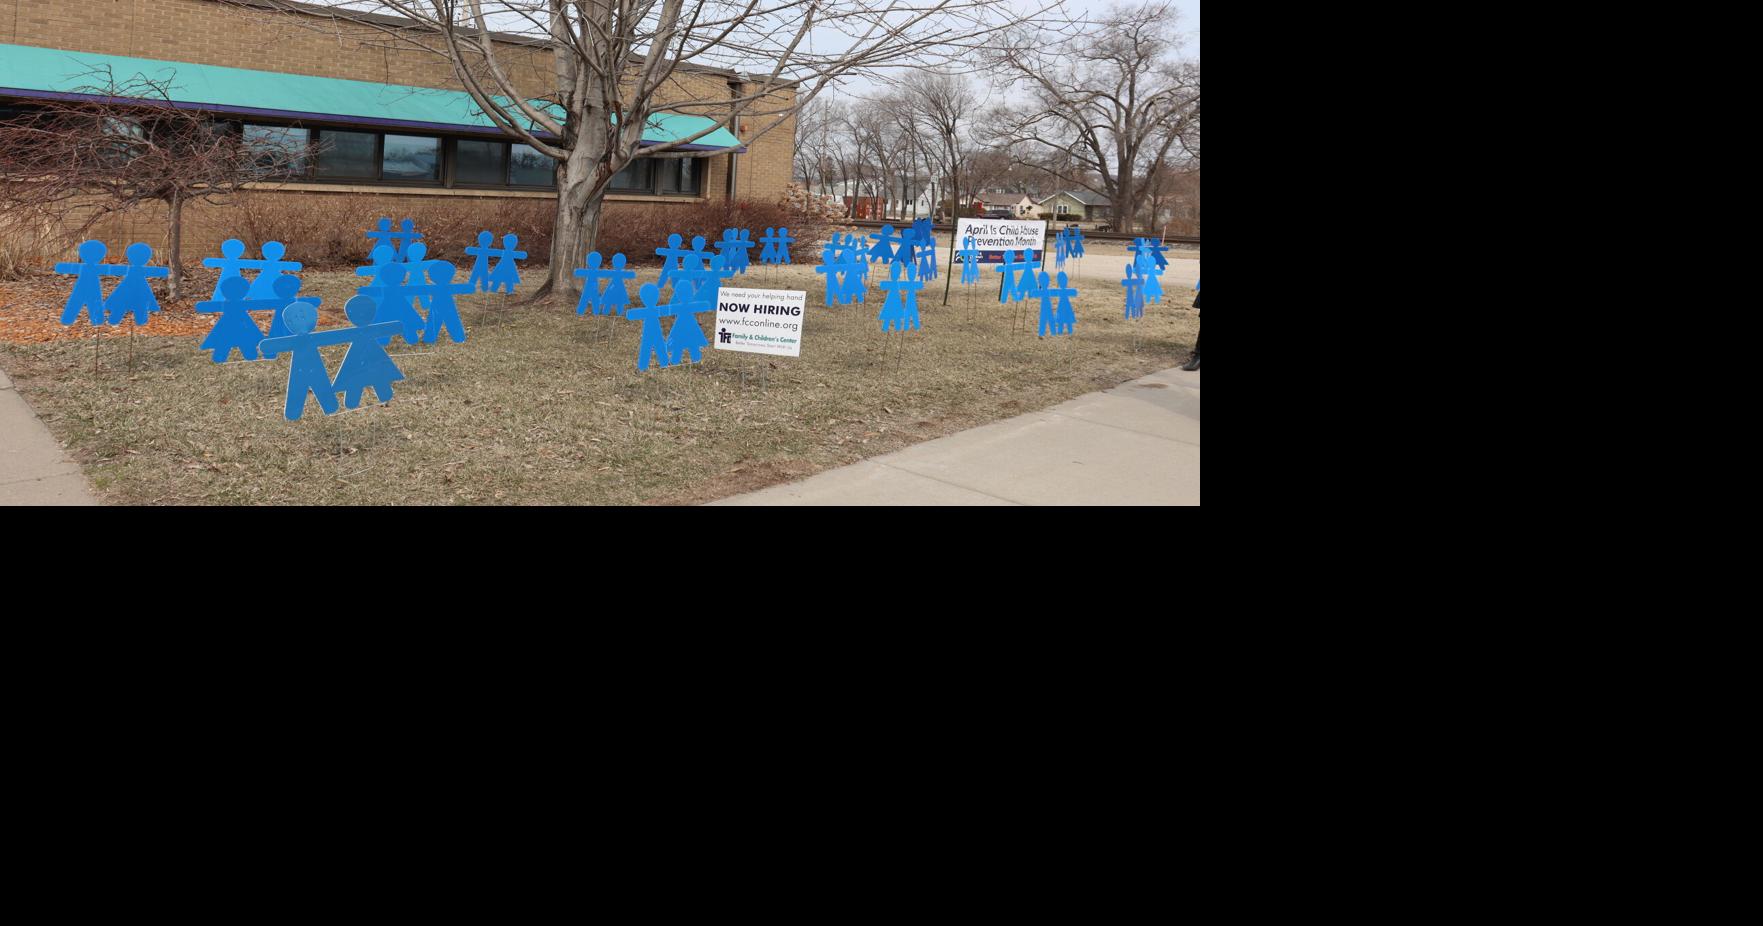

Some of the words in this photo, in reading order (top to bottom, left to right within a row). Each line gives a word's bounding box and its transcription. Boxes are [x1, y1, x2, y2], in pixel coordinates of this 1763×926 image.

[965, 224, 988, 235] April
[991, 225, 997, 235] Is
[999, 224, 1019, 235] Child
[1015, 236, 1037, 246] Month
[762, 293, 785, 301] helping
[719, 302, 750, 313] NOW
[753, 304, 801, 316] HIRING
[719, 317, 798, 332] www.fcconline.org
[732, 332, 748, 340] Family
[754, 334, 779, 342] Children's
